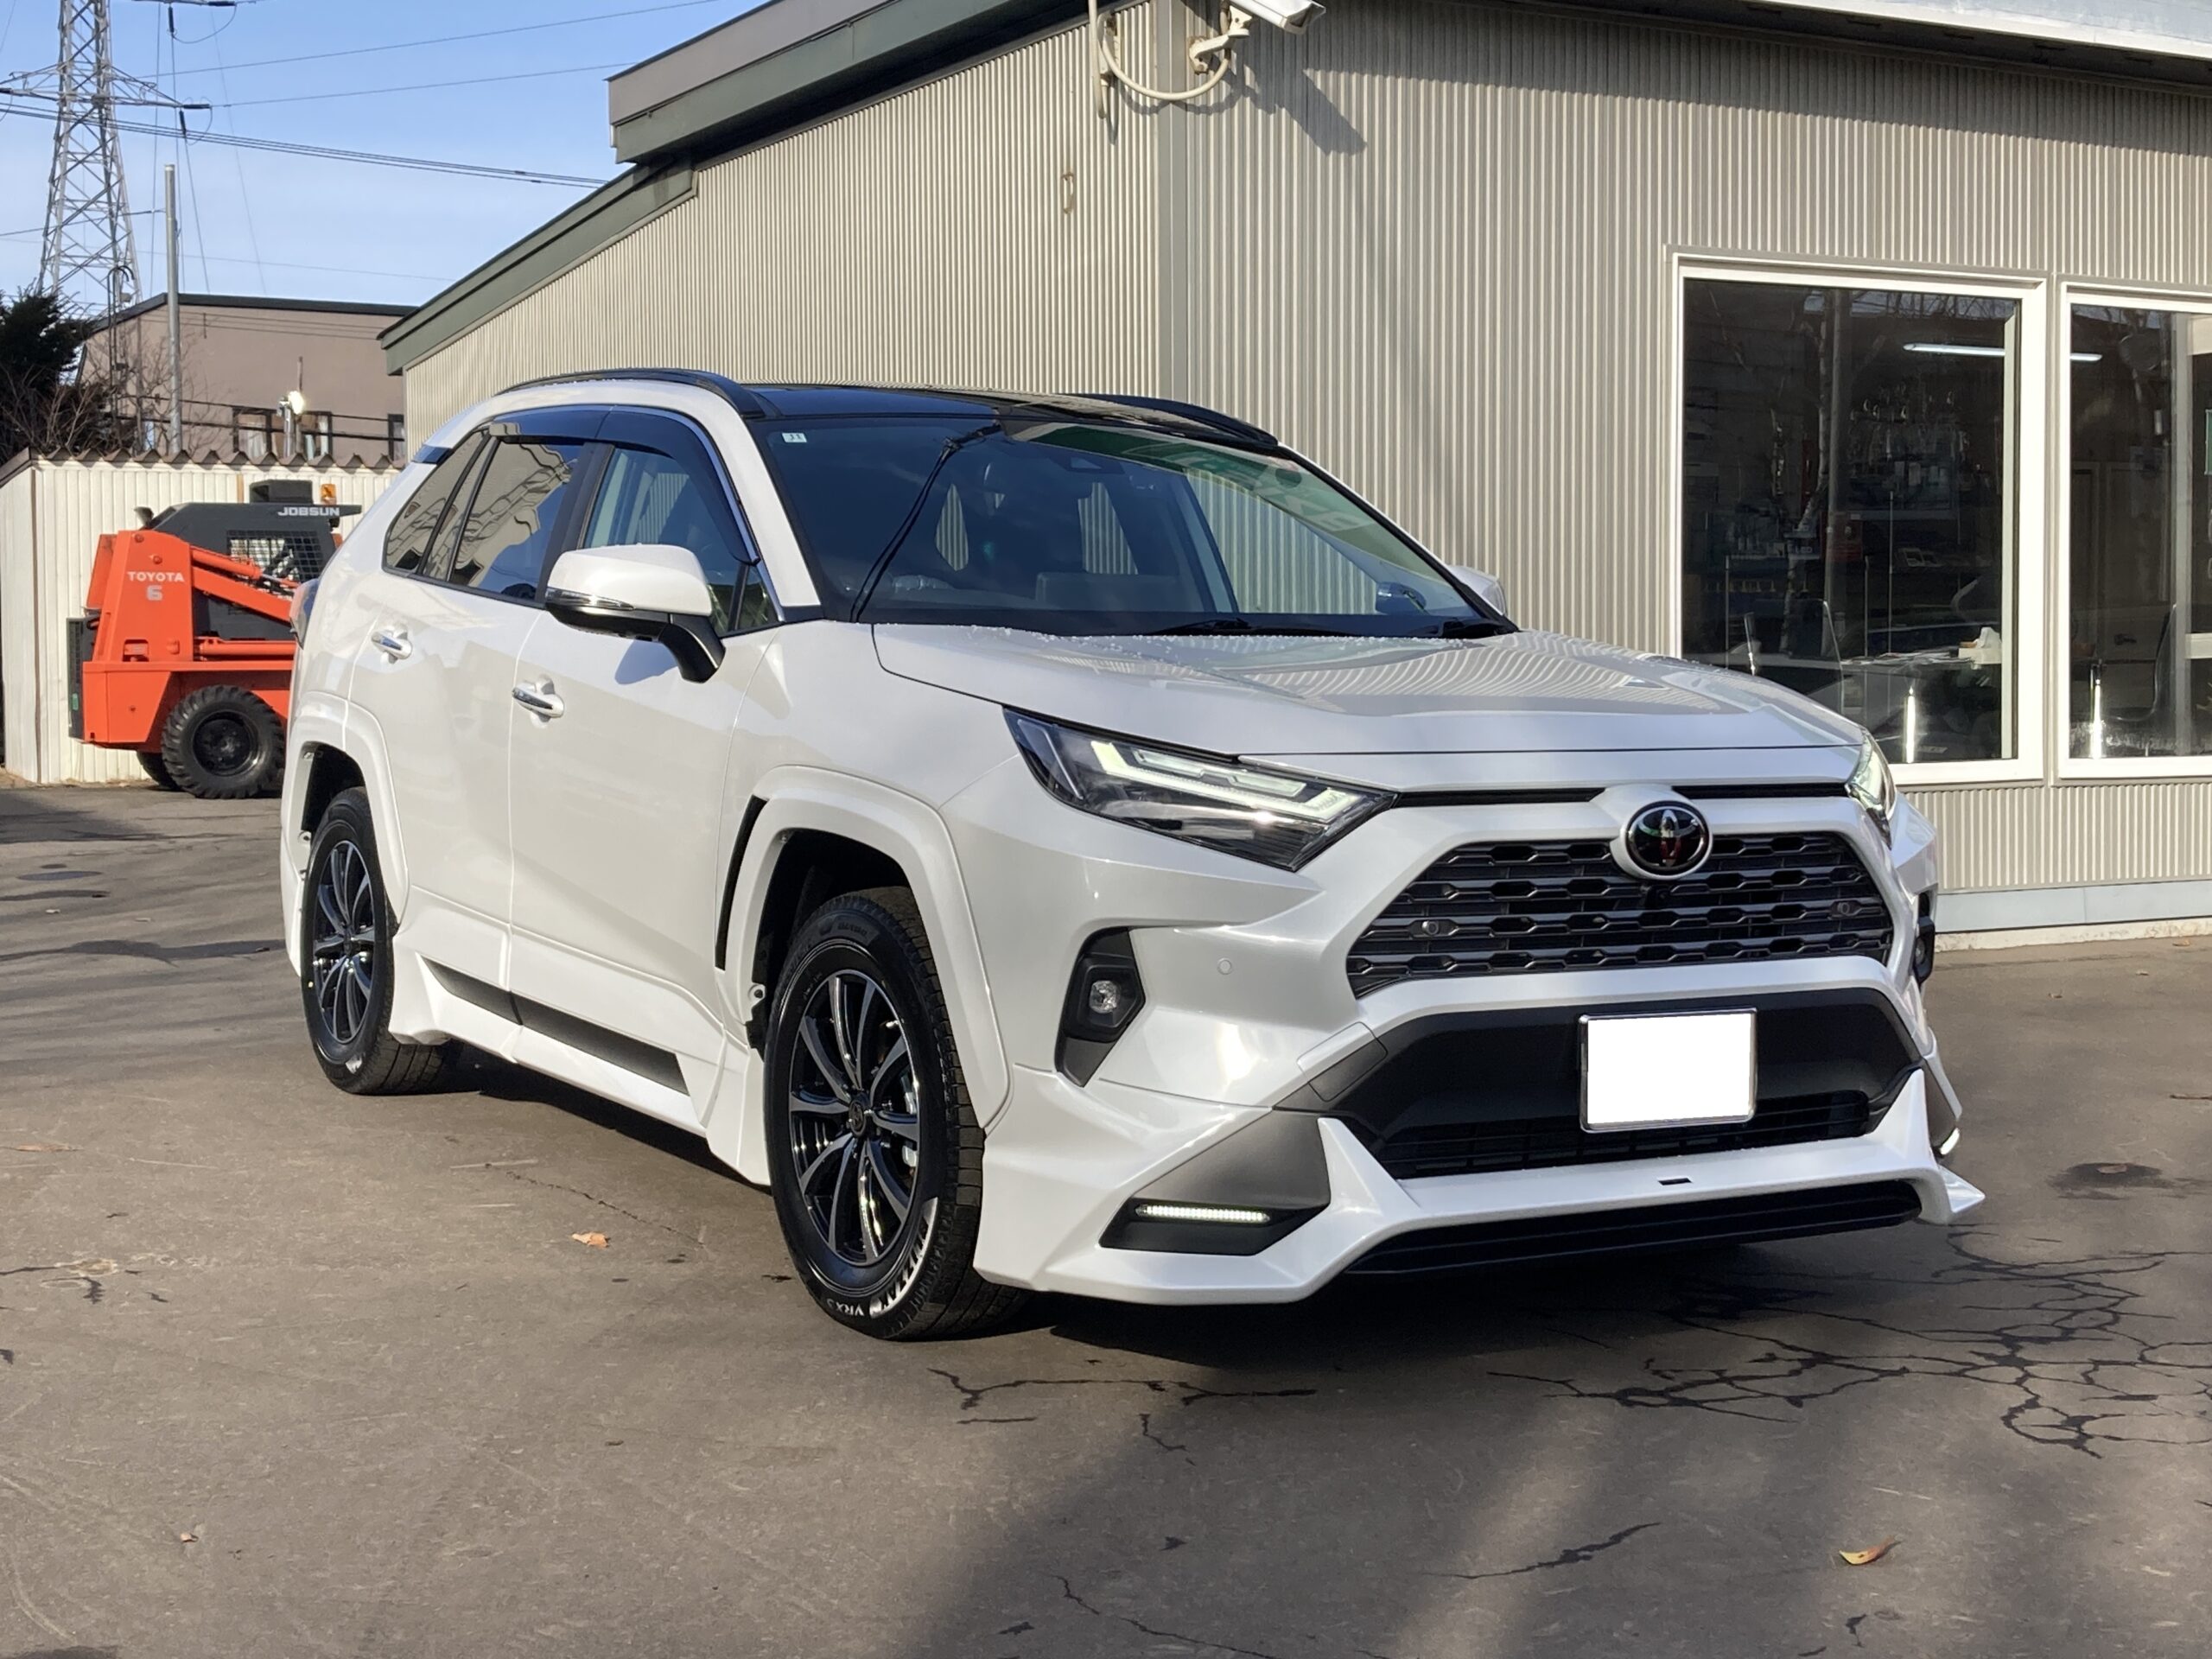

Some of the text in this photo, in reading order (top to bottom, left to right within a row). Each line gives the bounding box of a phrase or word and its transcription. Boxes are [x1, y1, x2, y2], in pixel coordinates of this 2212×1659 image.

[277, 506, 340, 516] JOBSUN
[127, 571, 185, 582] TOYOTA
[146, 585, 162, 601] 6
